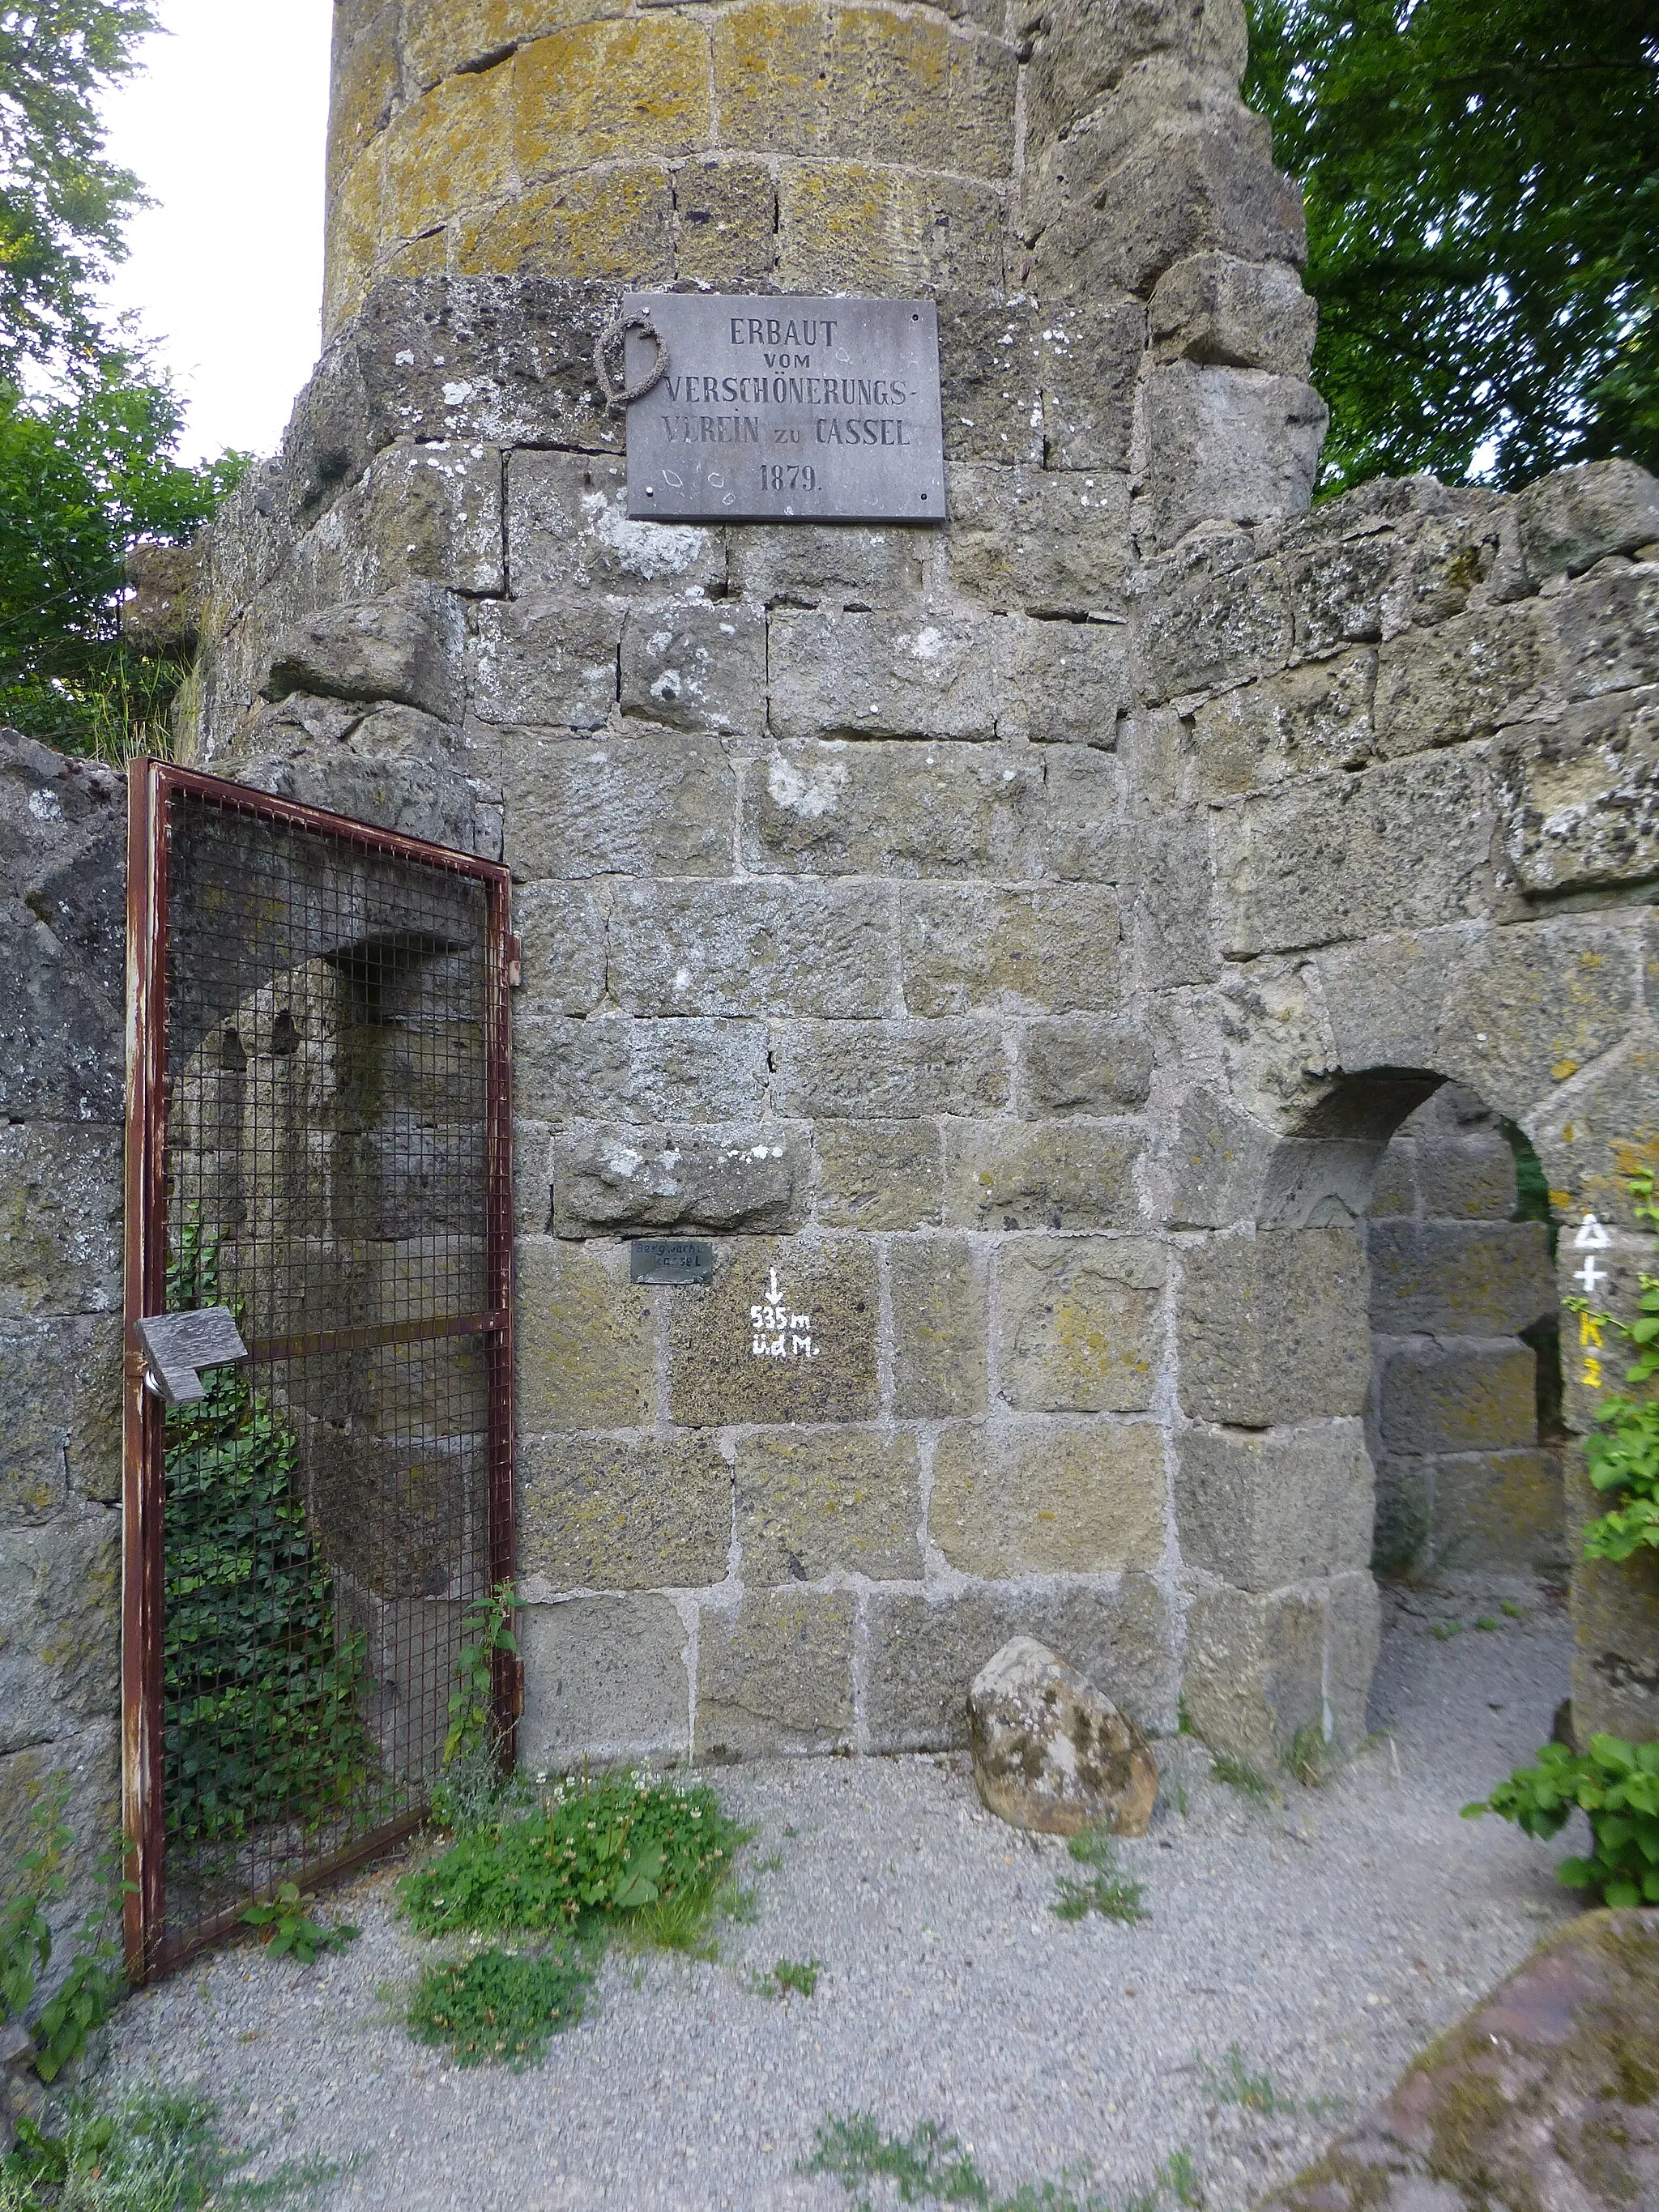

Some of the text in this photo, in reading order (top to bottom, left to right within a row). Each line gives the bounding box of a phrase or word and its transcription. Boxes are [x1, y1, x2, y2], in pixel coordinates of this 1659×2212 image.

[731, 318, 838, 347] ERBAUT
[763, 354, 810, 369] VOM
[663, 370, 917, 406] VERSCHÖNERUNGS-
[661, 407, 759, 443] VEREIN
[816, 418, 911, 445] CASSEL
[759, 464, 823, 492] 1879.
